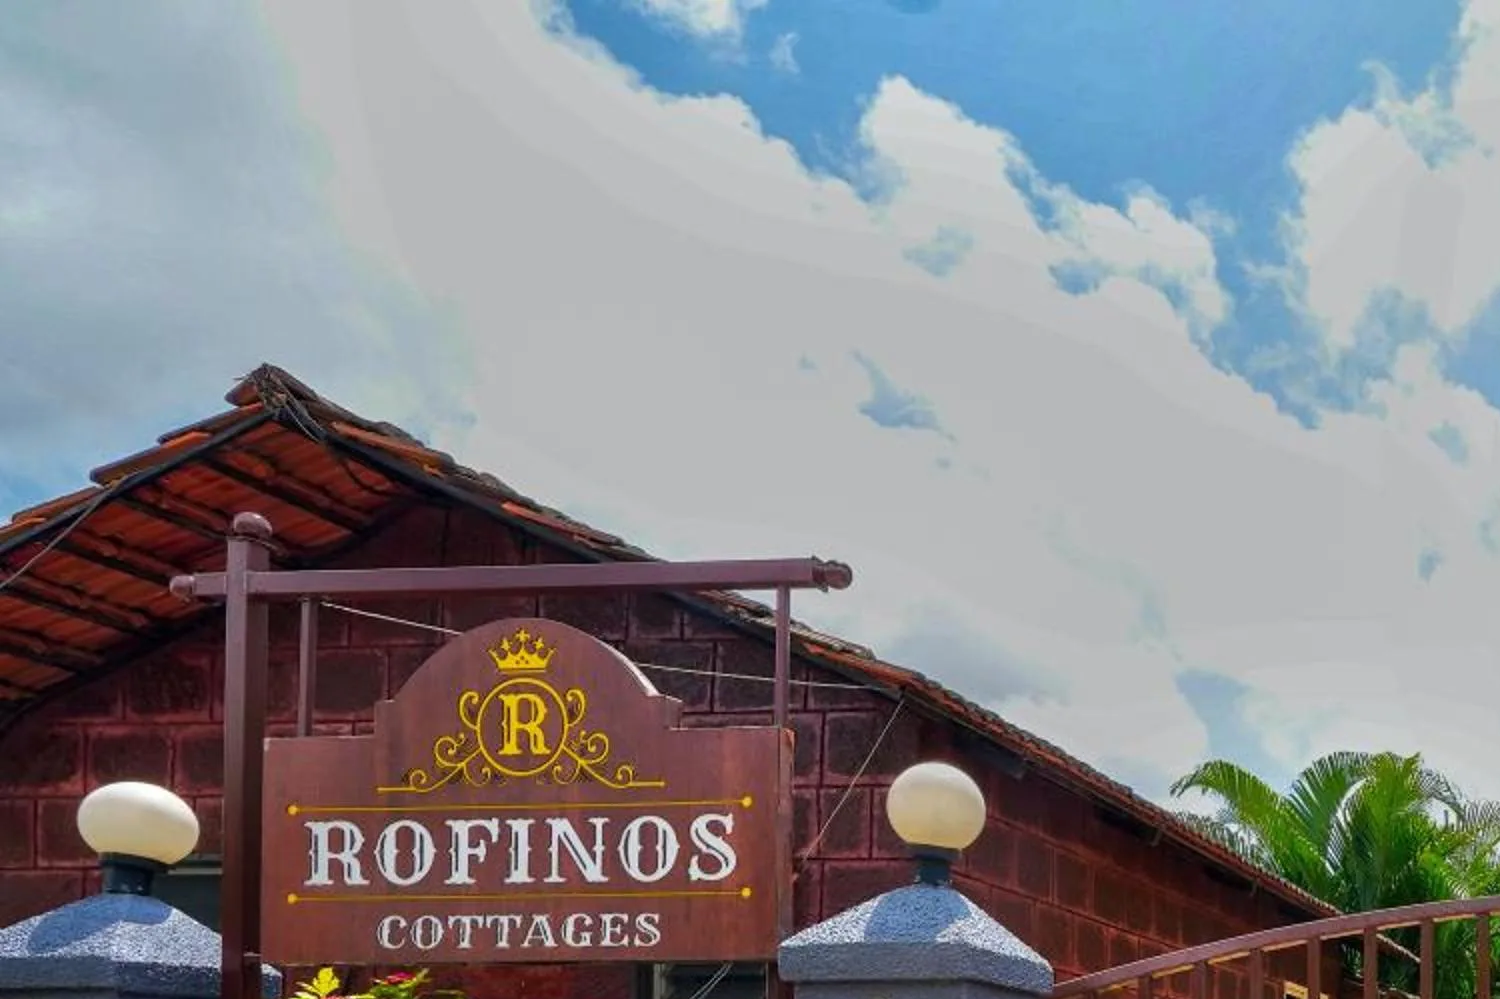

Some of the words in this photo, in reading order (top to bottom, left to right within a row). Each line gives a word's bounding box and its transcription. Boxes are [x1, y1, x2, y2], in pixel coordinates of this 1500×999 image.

[499, 693, 551, 755] R
[303, 813, 738, 886] ROFINOS
[376, 912, 662, 950] COTTAGES
